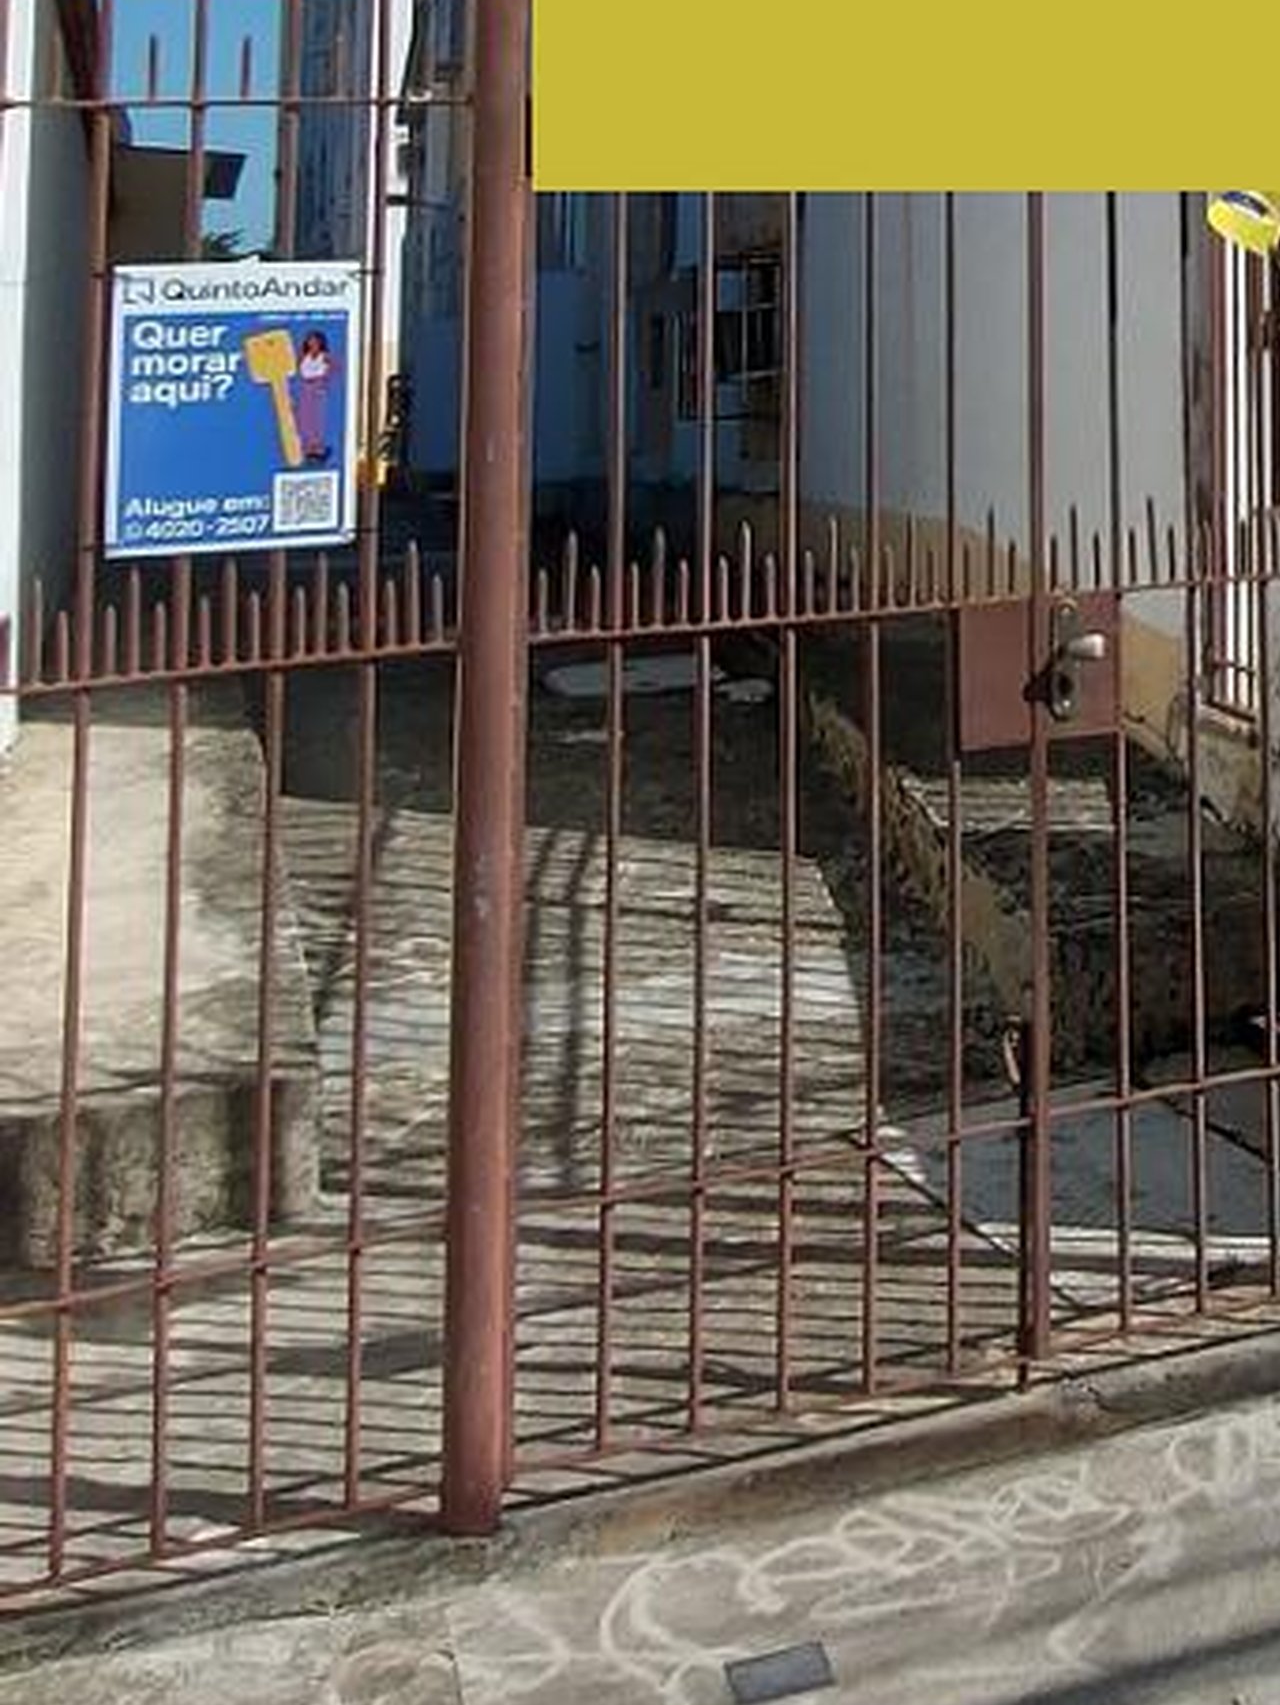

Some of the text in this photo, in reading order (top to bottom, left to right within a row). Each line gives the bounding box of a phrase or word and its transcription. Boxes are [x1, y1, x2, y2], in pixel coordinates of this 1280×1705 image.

[161, 277, 349, 301] QuintoAndar
[132, 321, 228, 349] Quer
[131, 351, 241, 376] morar
[129, 375, 234, 407] aqui?
[124, 497, 218, 518] Alugue
